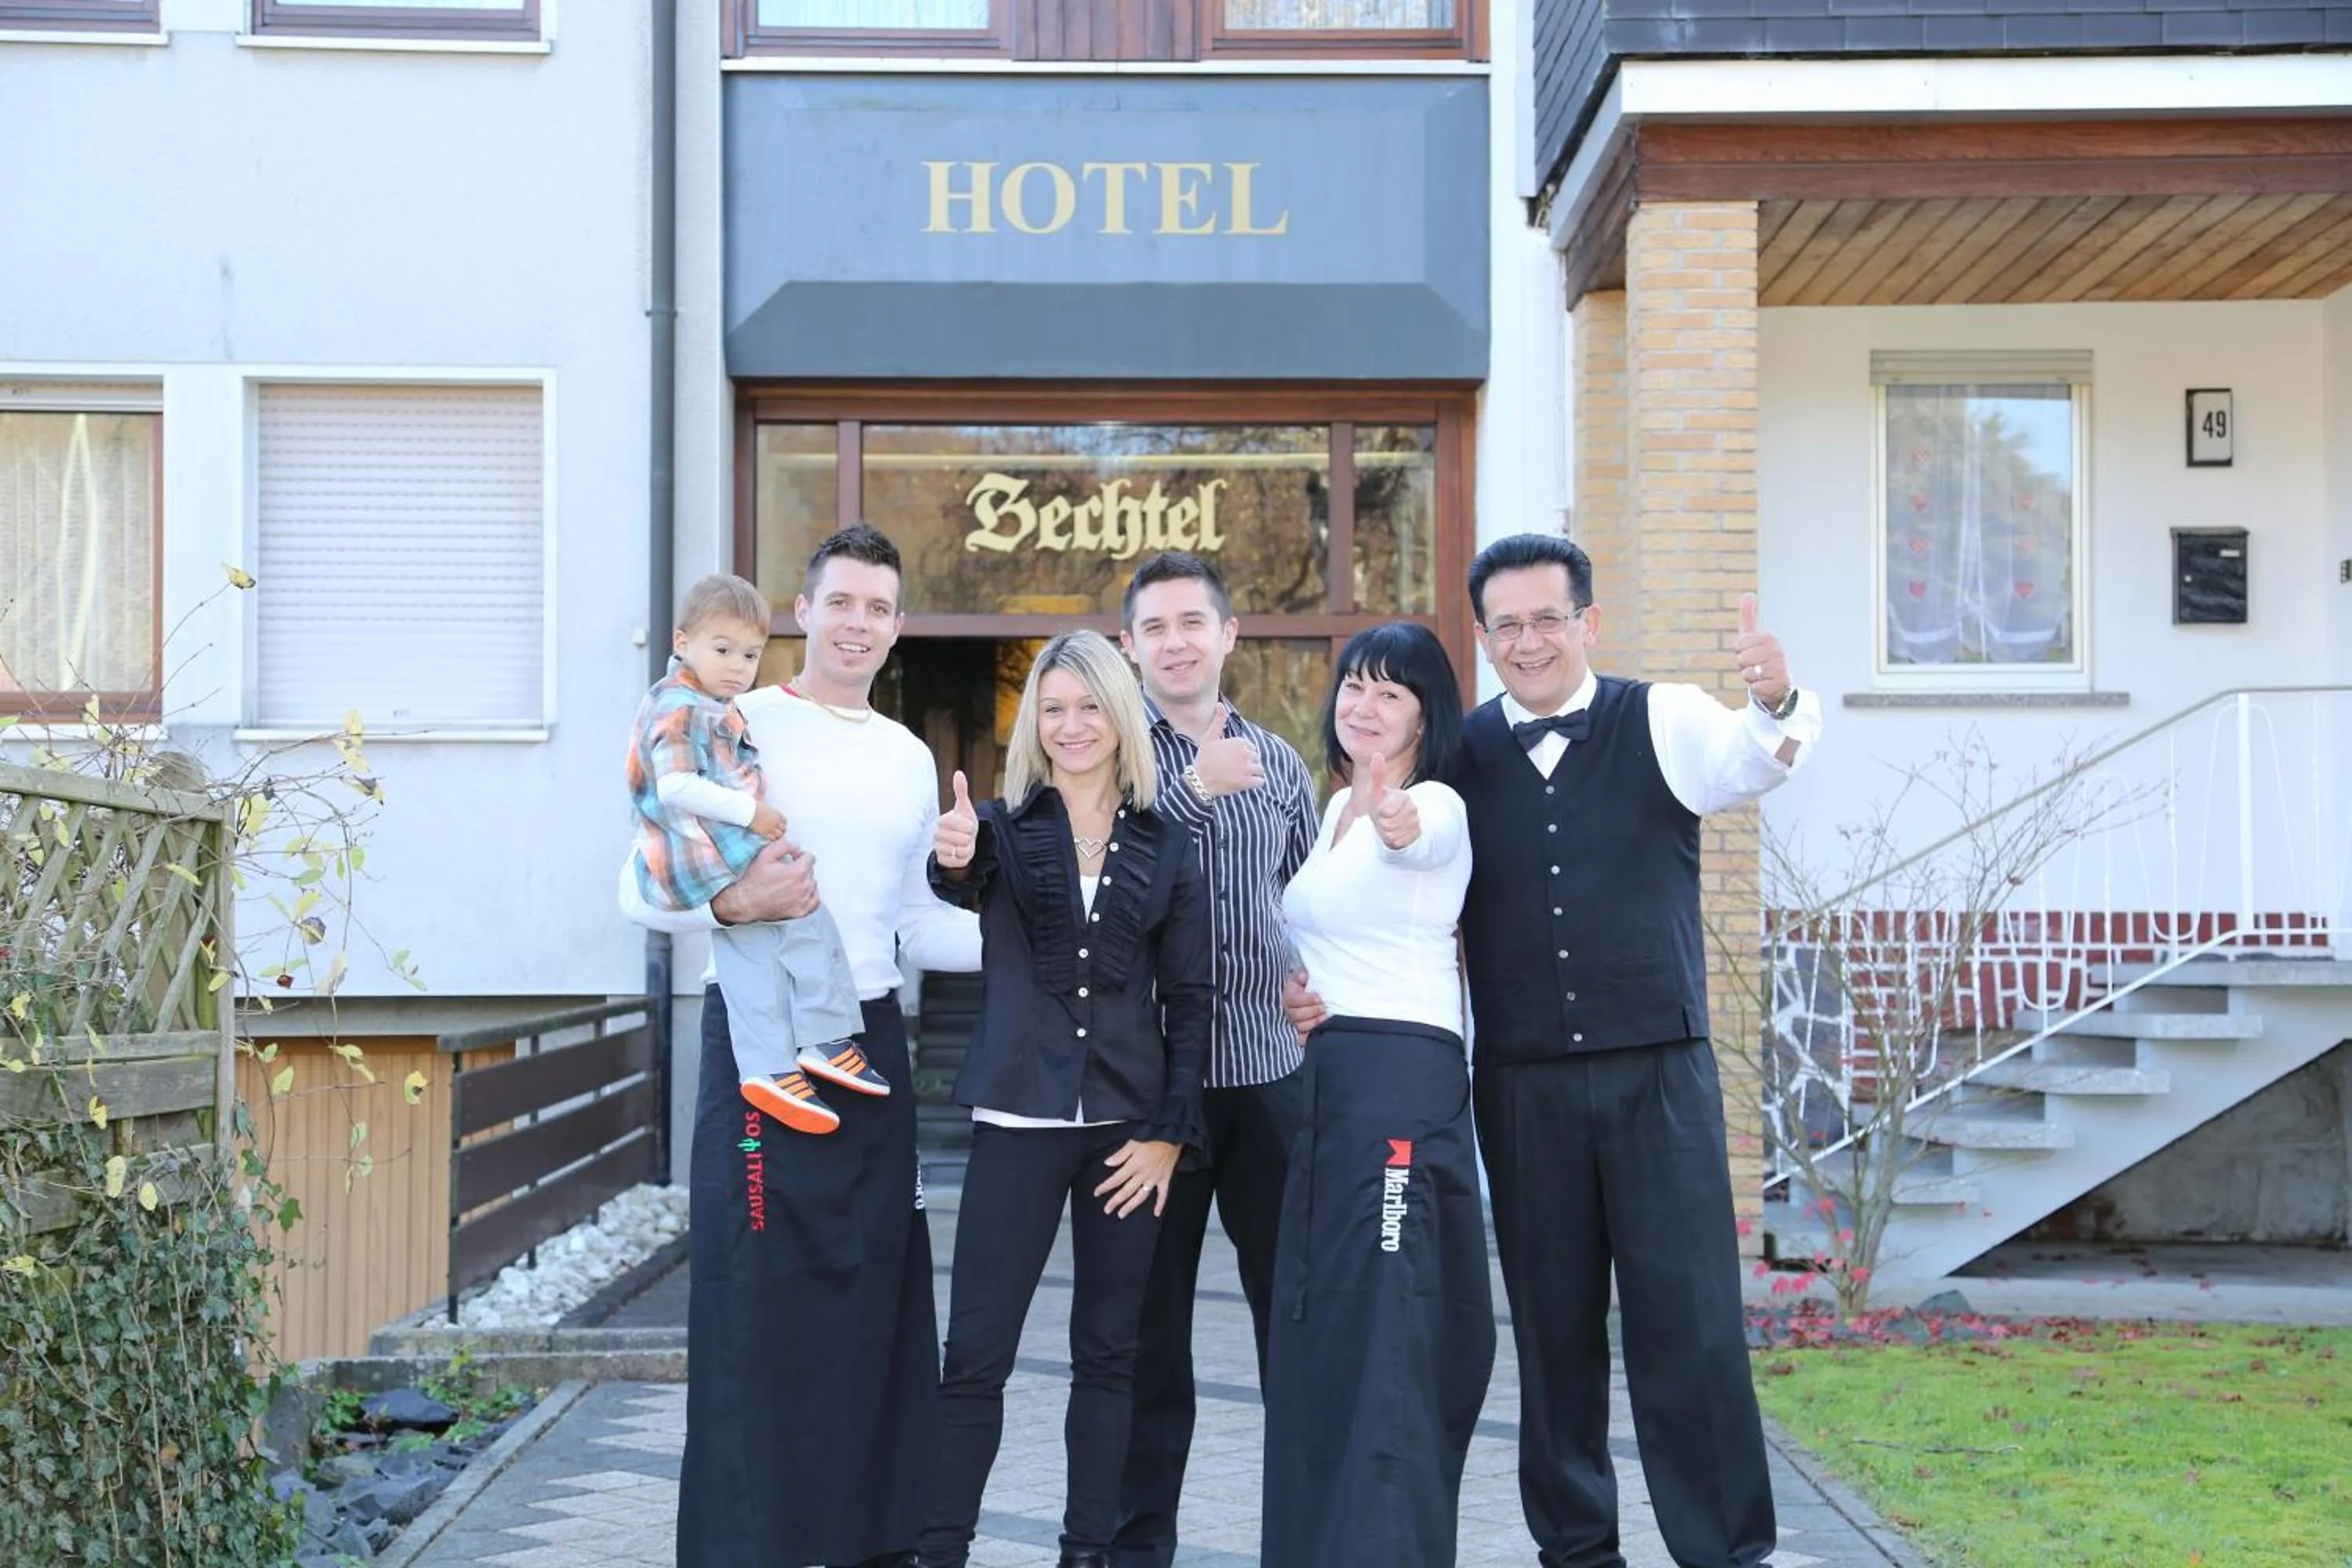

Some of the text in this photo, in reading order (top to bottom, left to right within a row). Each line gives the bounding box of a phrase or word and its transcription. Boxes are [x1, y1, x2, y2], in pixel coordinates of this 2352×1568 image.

[920, 161, 1290, 234] HOTEL
[2202, 410, 2227, 438] 49
[965, 473, 1228, 561] Bechtel
[1381, 1167, 1410, 1252] Marlboro
